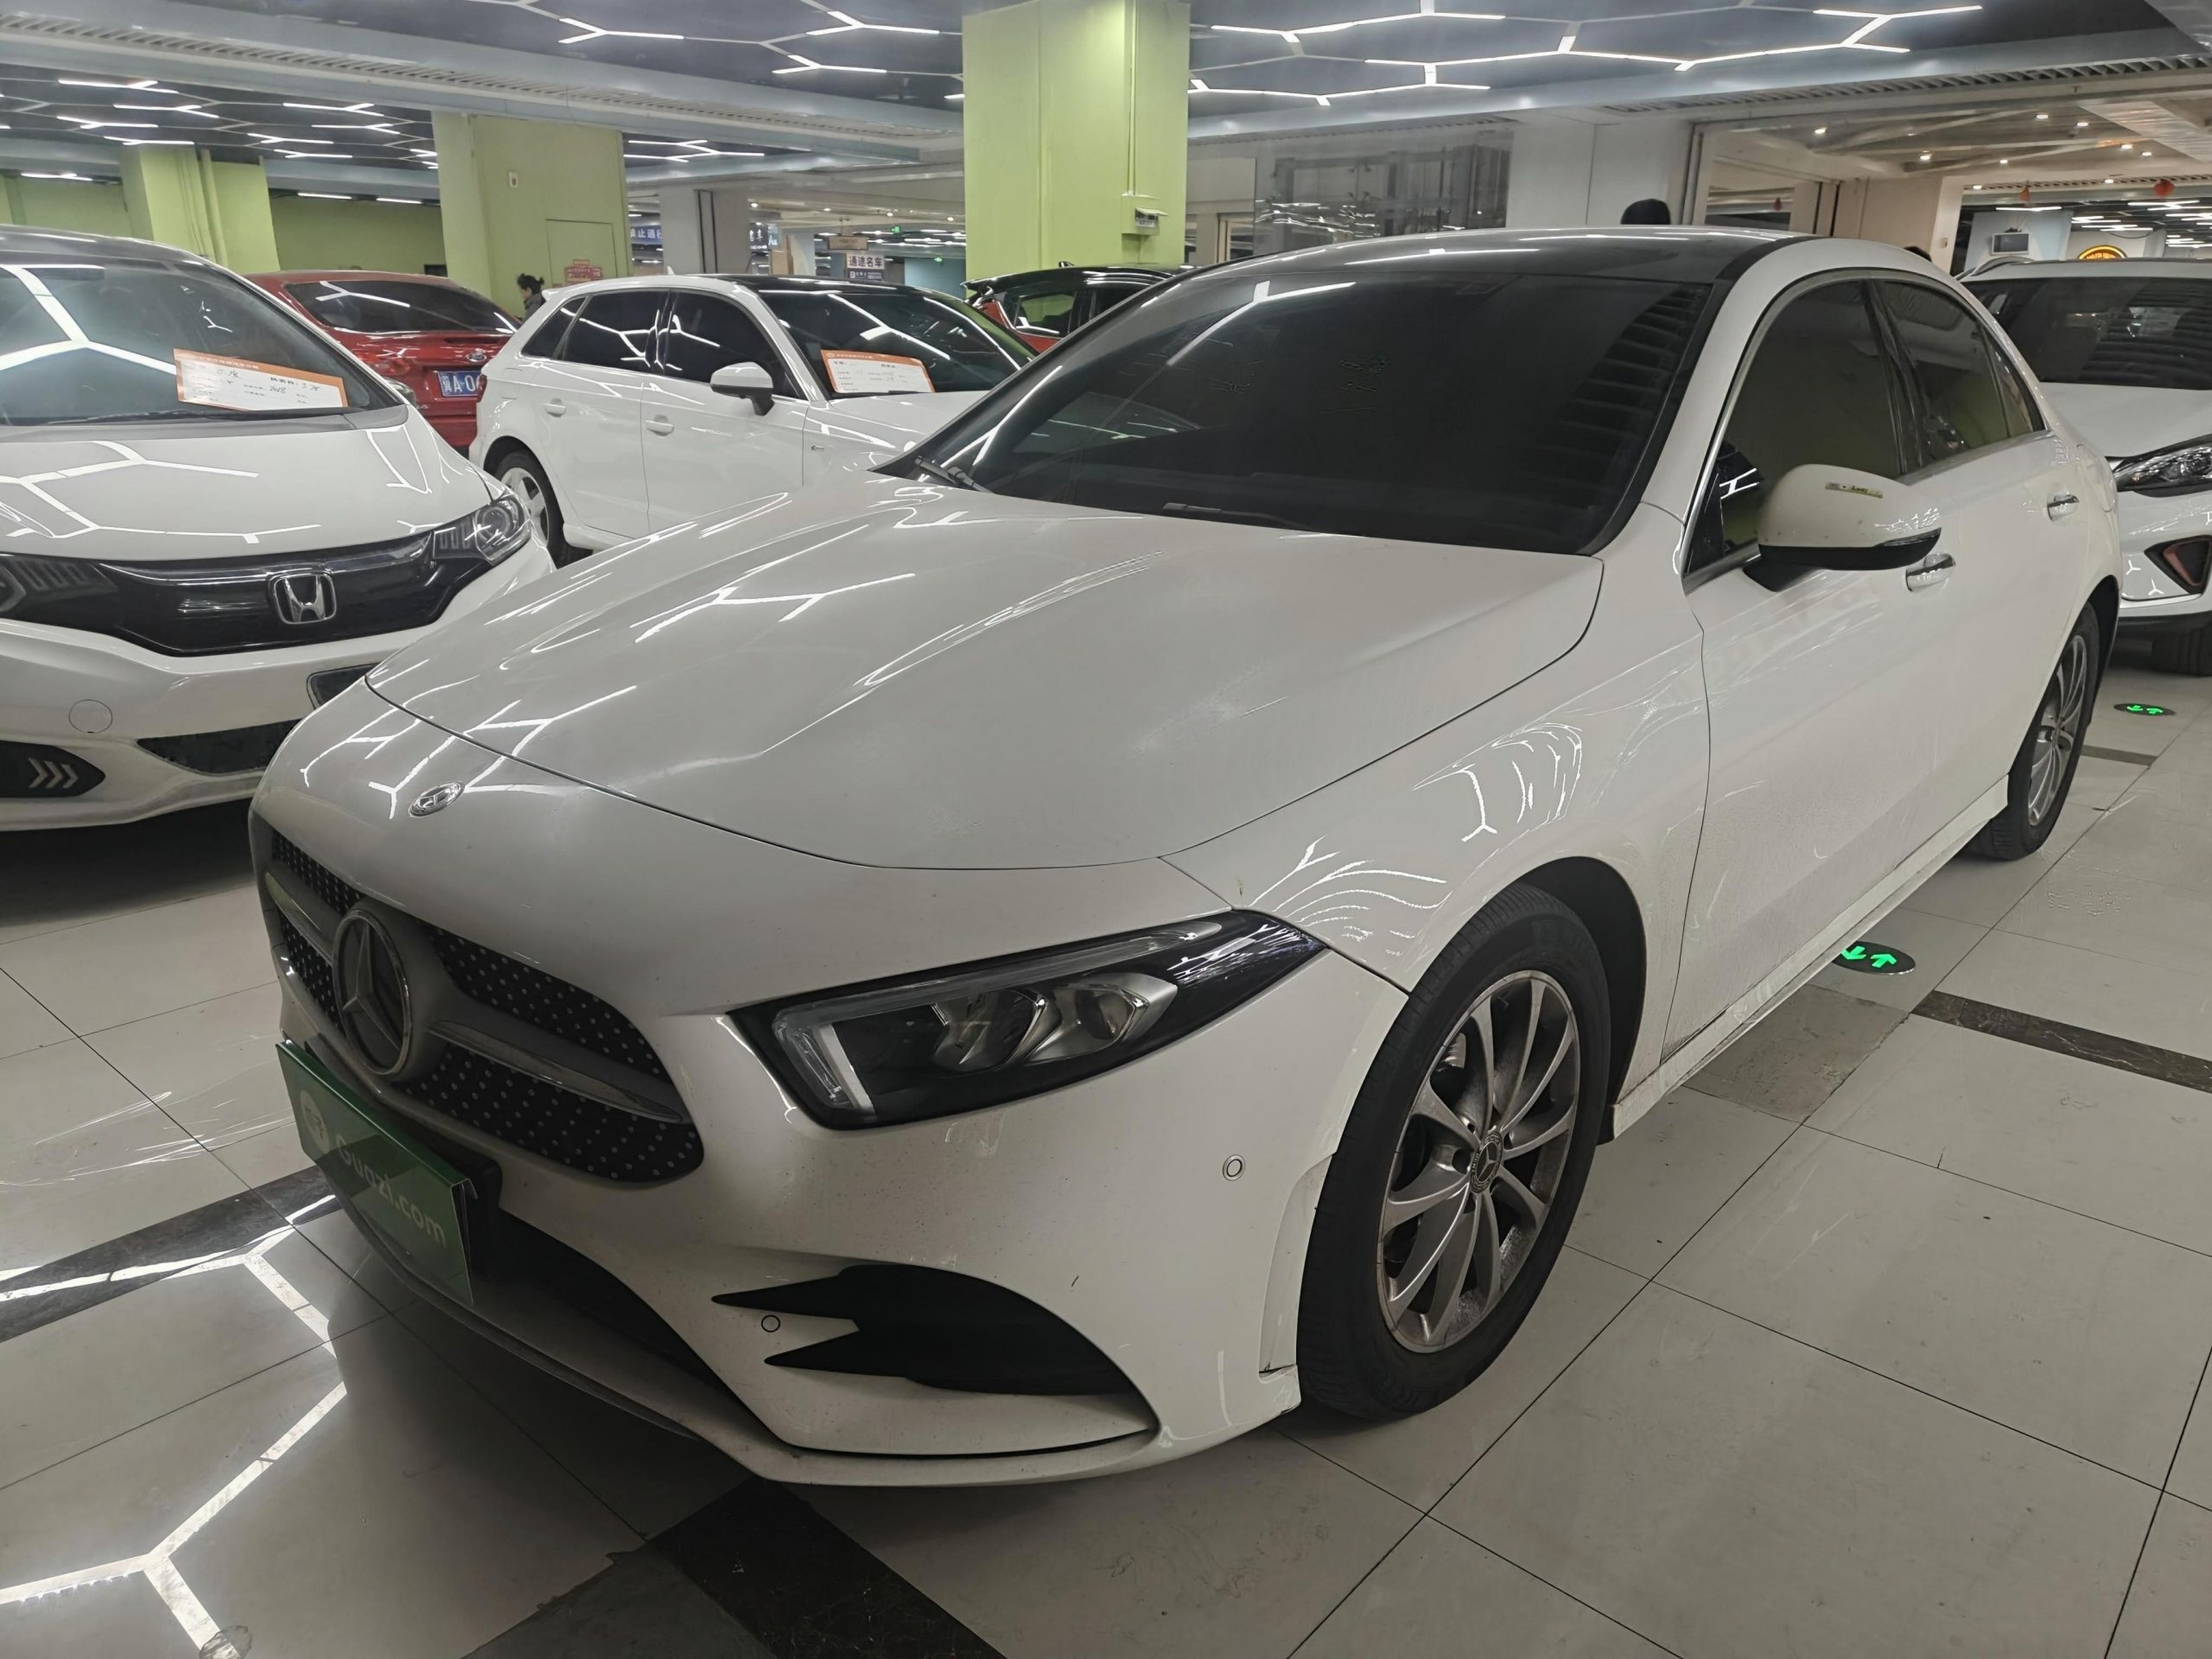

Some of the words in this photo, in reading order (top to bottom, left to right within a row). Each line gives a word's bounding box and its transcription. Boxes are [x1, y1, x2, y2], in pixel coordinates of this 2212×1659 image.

[849, 255, 884, 267] 通途名车
[336, 1133, 447, 1248] Guazi.com
